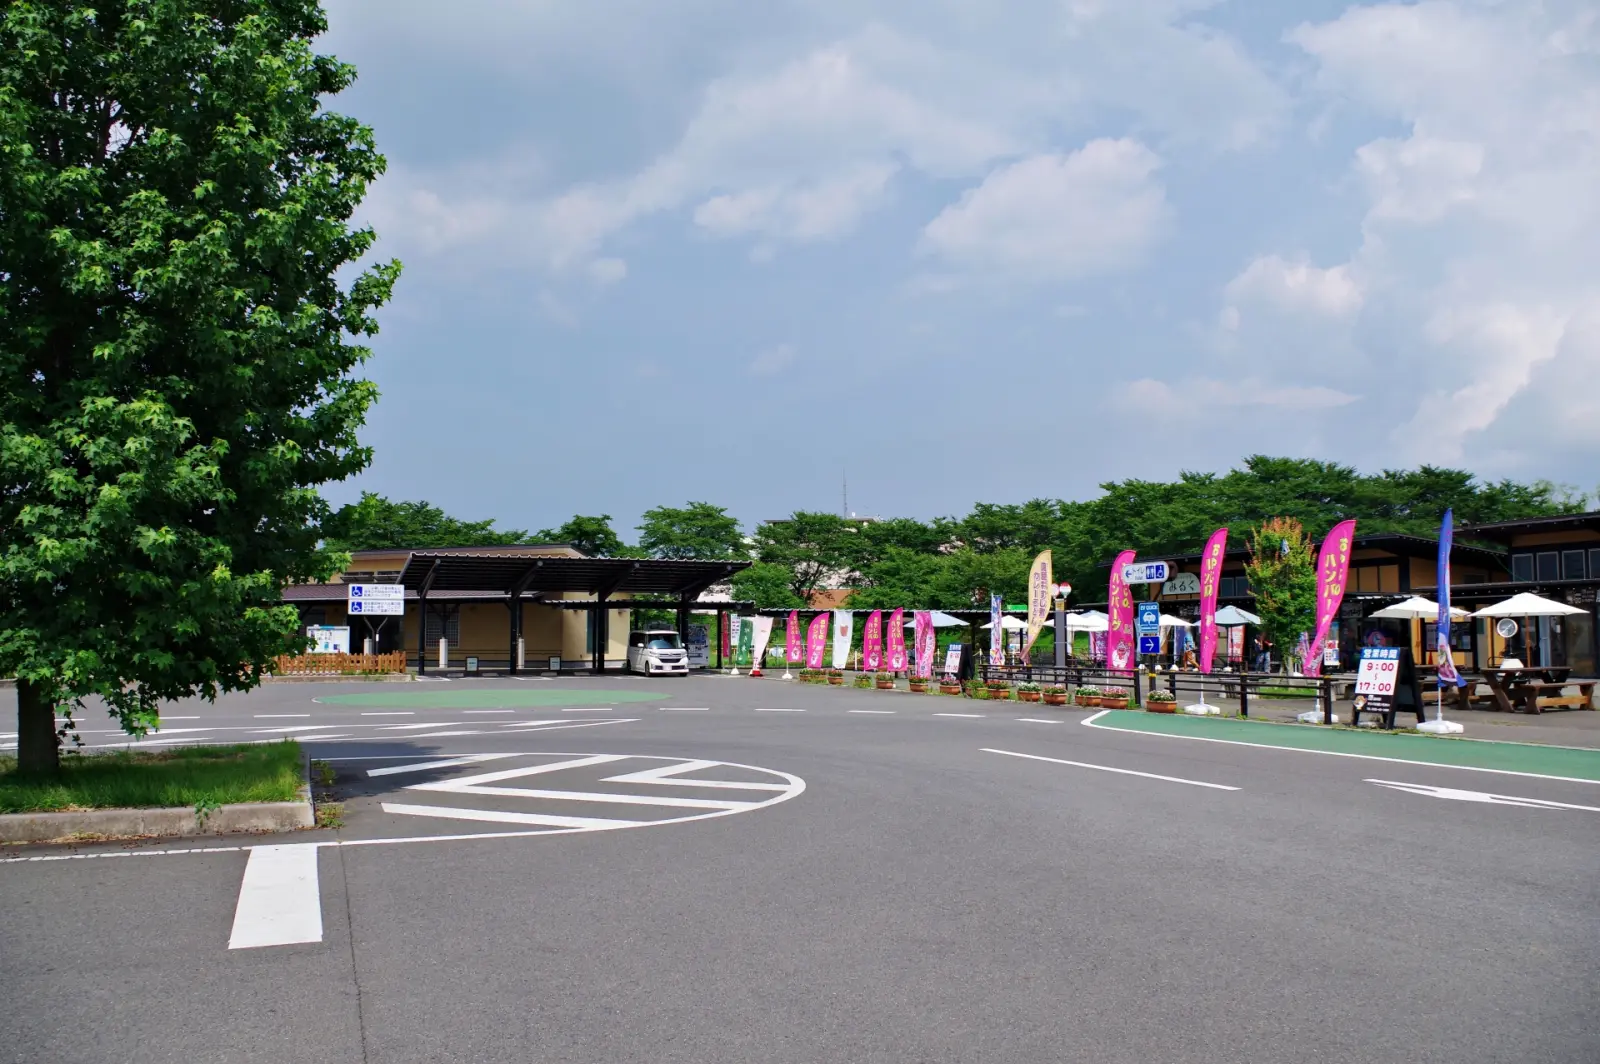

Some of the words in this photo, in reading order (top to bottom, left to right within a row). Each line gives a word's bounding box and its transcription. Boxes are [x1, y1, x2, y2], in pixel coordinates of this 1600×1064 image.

[1169, 580, 1194, 592] みるく
[1111, 572, 1122, 631] ハンバーグ
[1363, 649, 1398, 659] 営業時間
[1366, 662, 1394, 672] 9:00
[1359, 682, 1391, 692] 17:00
